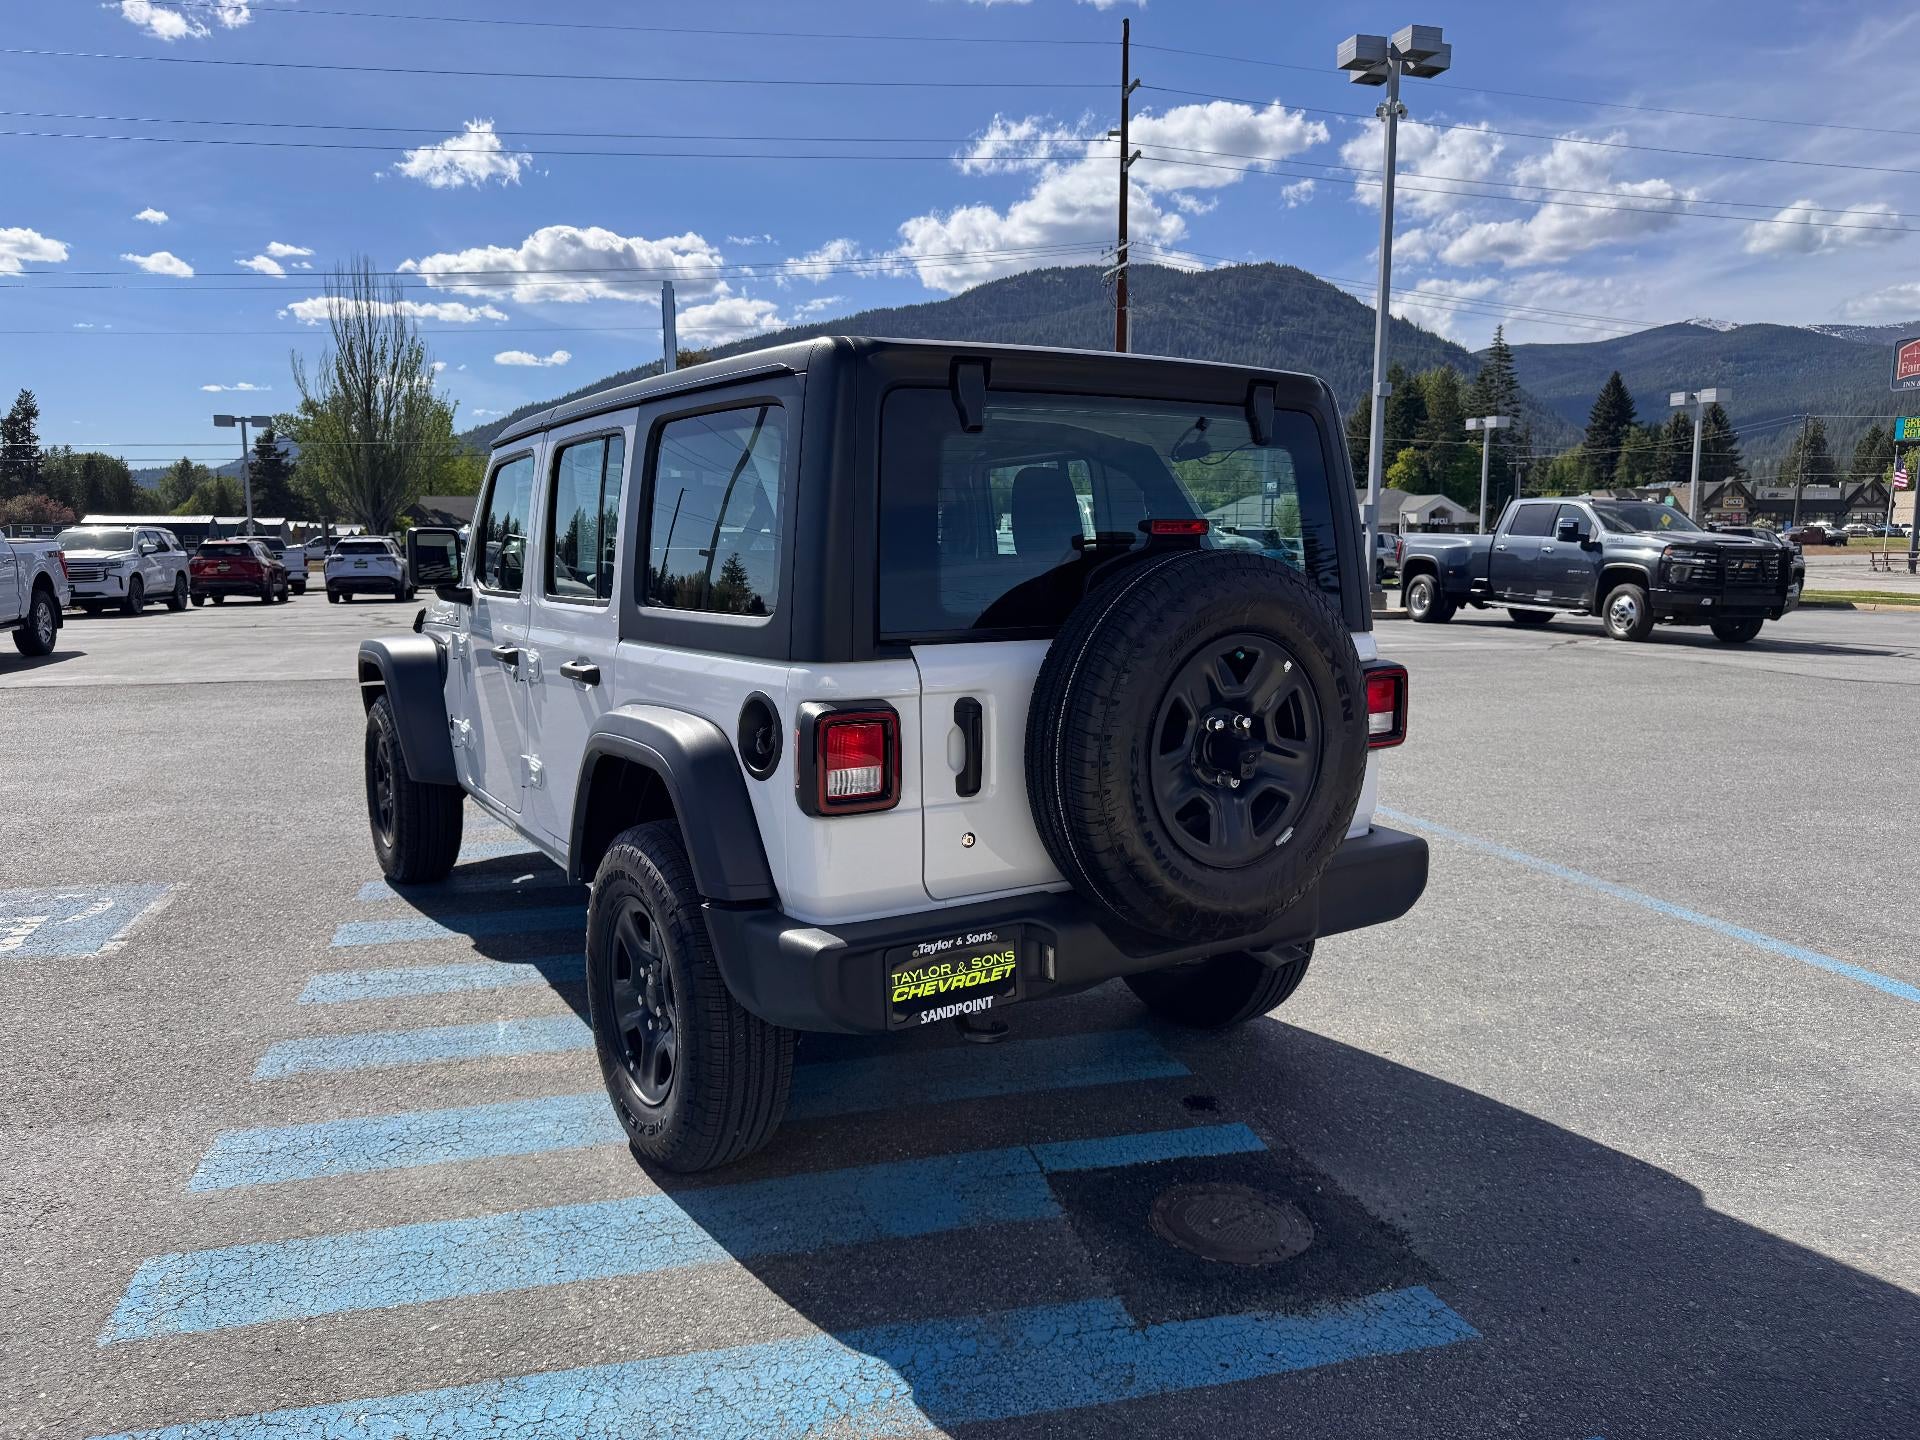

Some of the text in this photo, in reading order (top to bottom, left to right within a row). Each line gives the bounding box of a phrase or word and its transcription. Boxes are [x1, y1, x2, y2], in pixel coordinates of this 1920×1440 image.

[1903, 380, 1915, 389] INN
[918, 931, 993, 955] Taylor & Sons
[891, 950, 1015, 986] TAYLOR & SONS
[892, 964, 1016, 1003] CHEVROLET
[920, 996, 994, 1025] SANDPOINT
